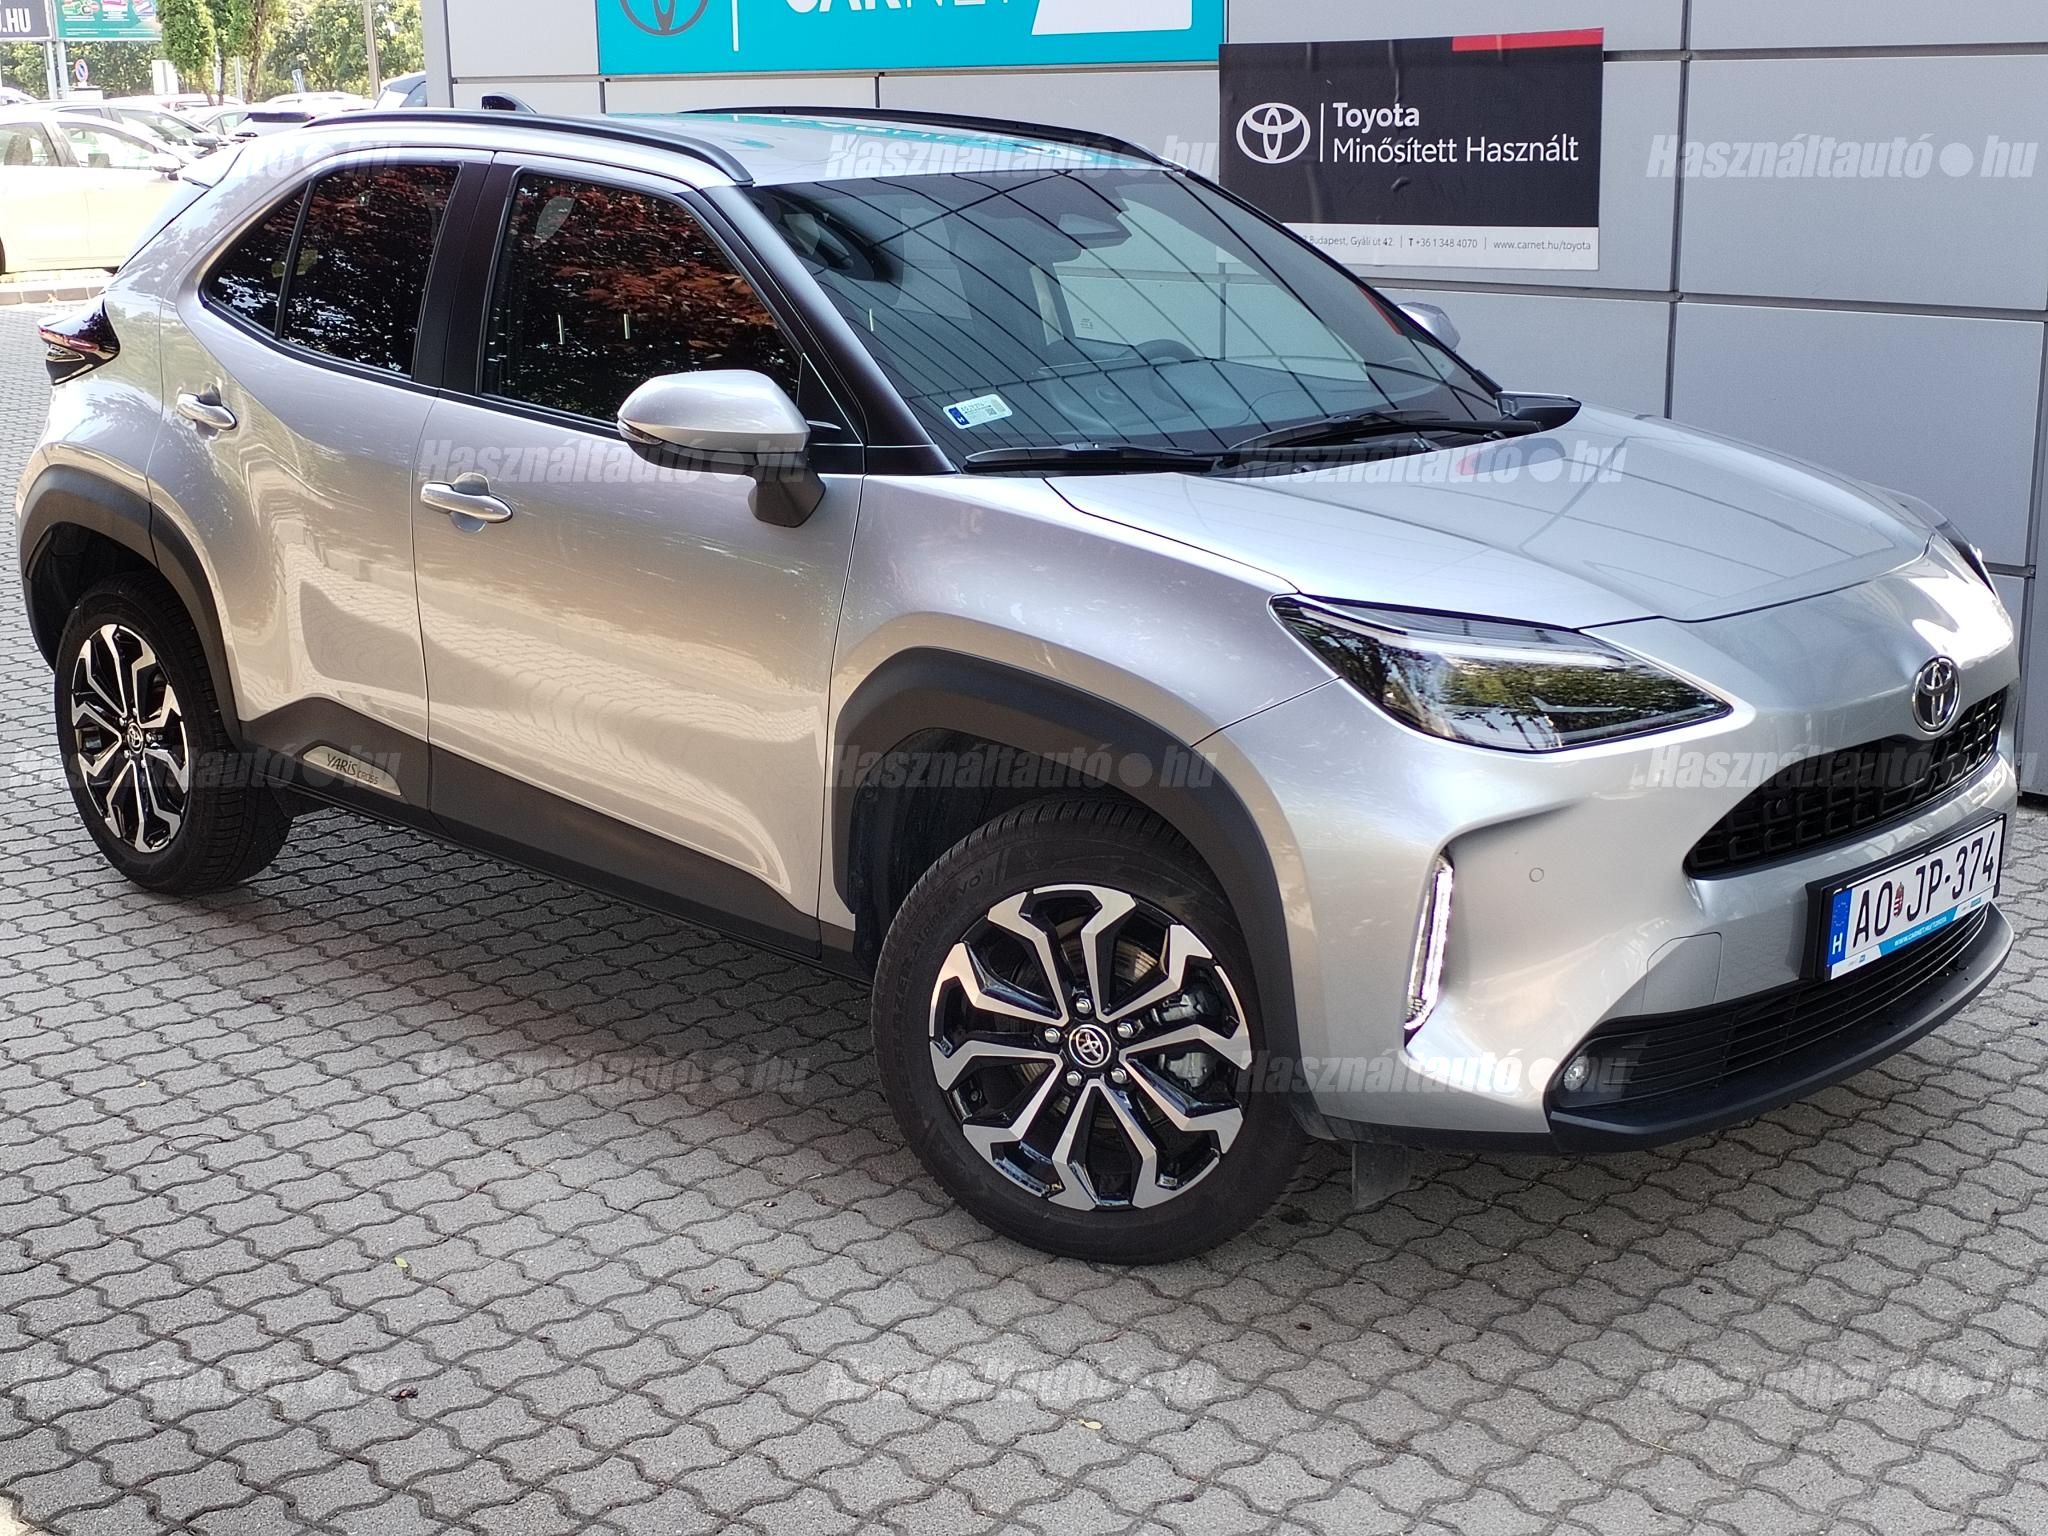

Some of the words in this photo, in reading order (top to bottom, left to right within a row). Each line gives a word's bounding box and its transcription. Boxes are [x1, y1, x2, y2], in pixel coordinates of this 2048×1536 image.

[1333, 102, 1420, 133] Toyota
[1333, 136, 1457, 163] Minősített
[1466, 133, 1579, 162] Használt
[1416, 238, 1431, 247] +36
[1439, 239, 1455, 247] 348
[1456, 239, 1478, 248] 4070
[1853, 880, 1893, 948] AO
[1831, 932, 1843, 955] H
